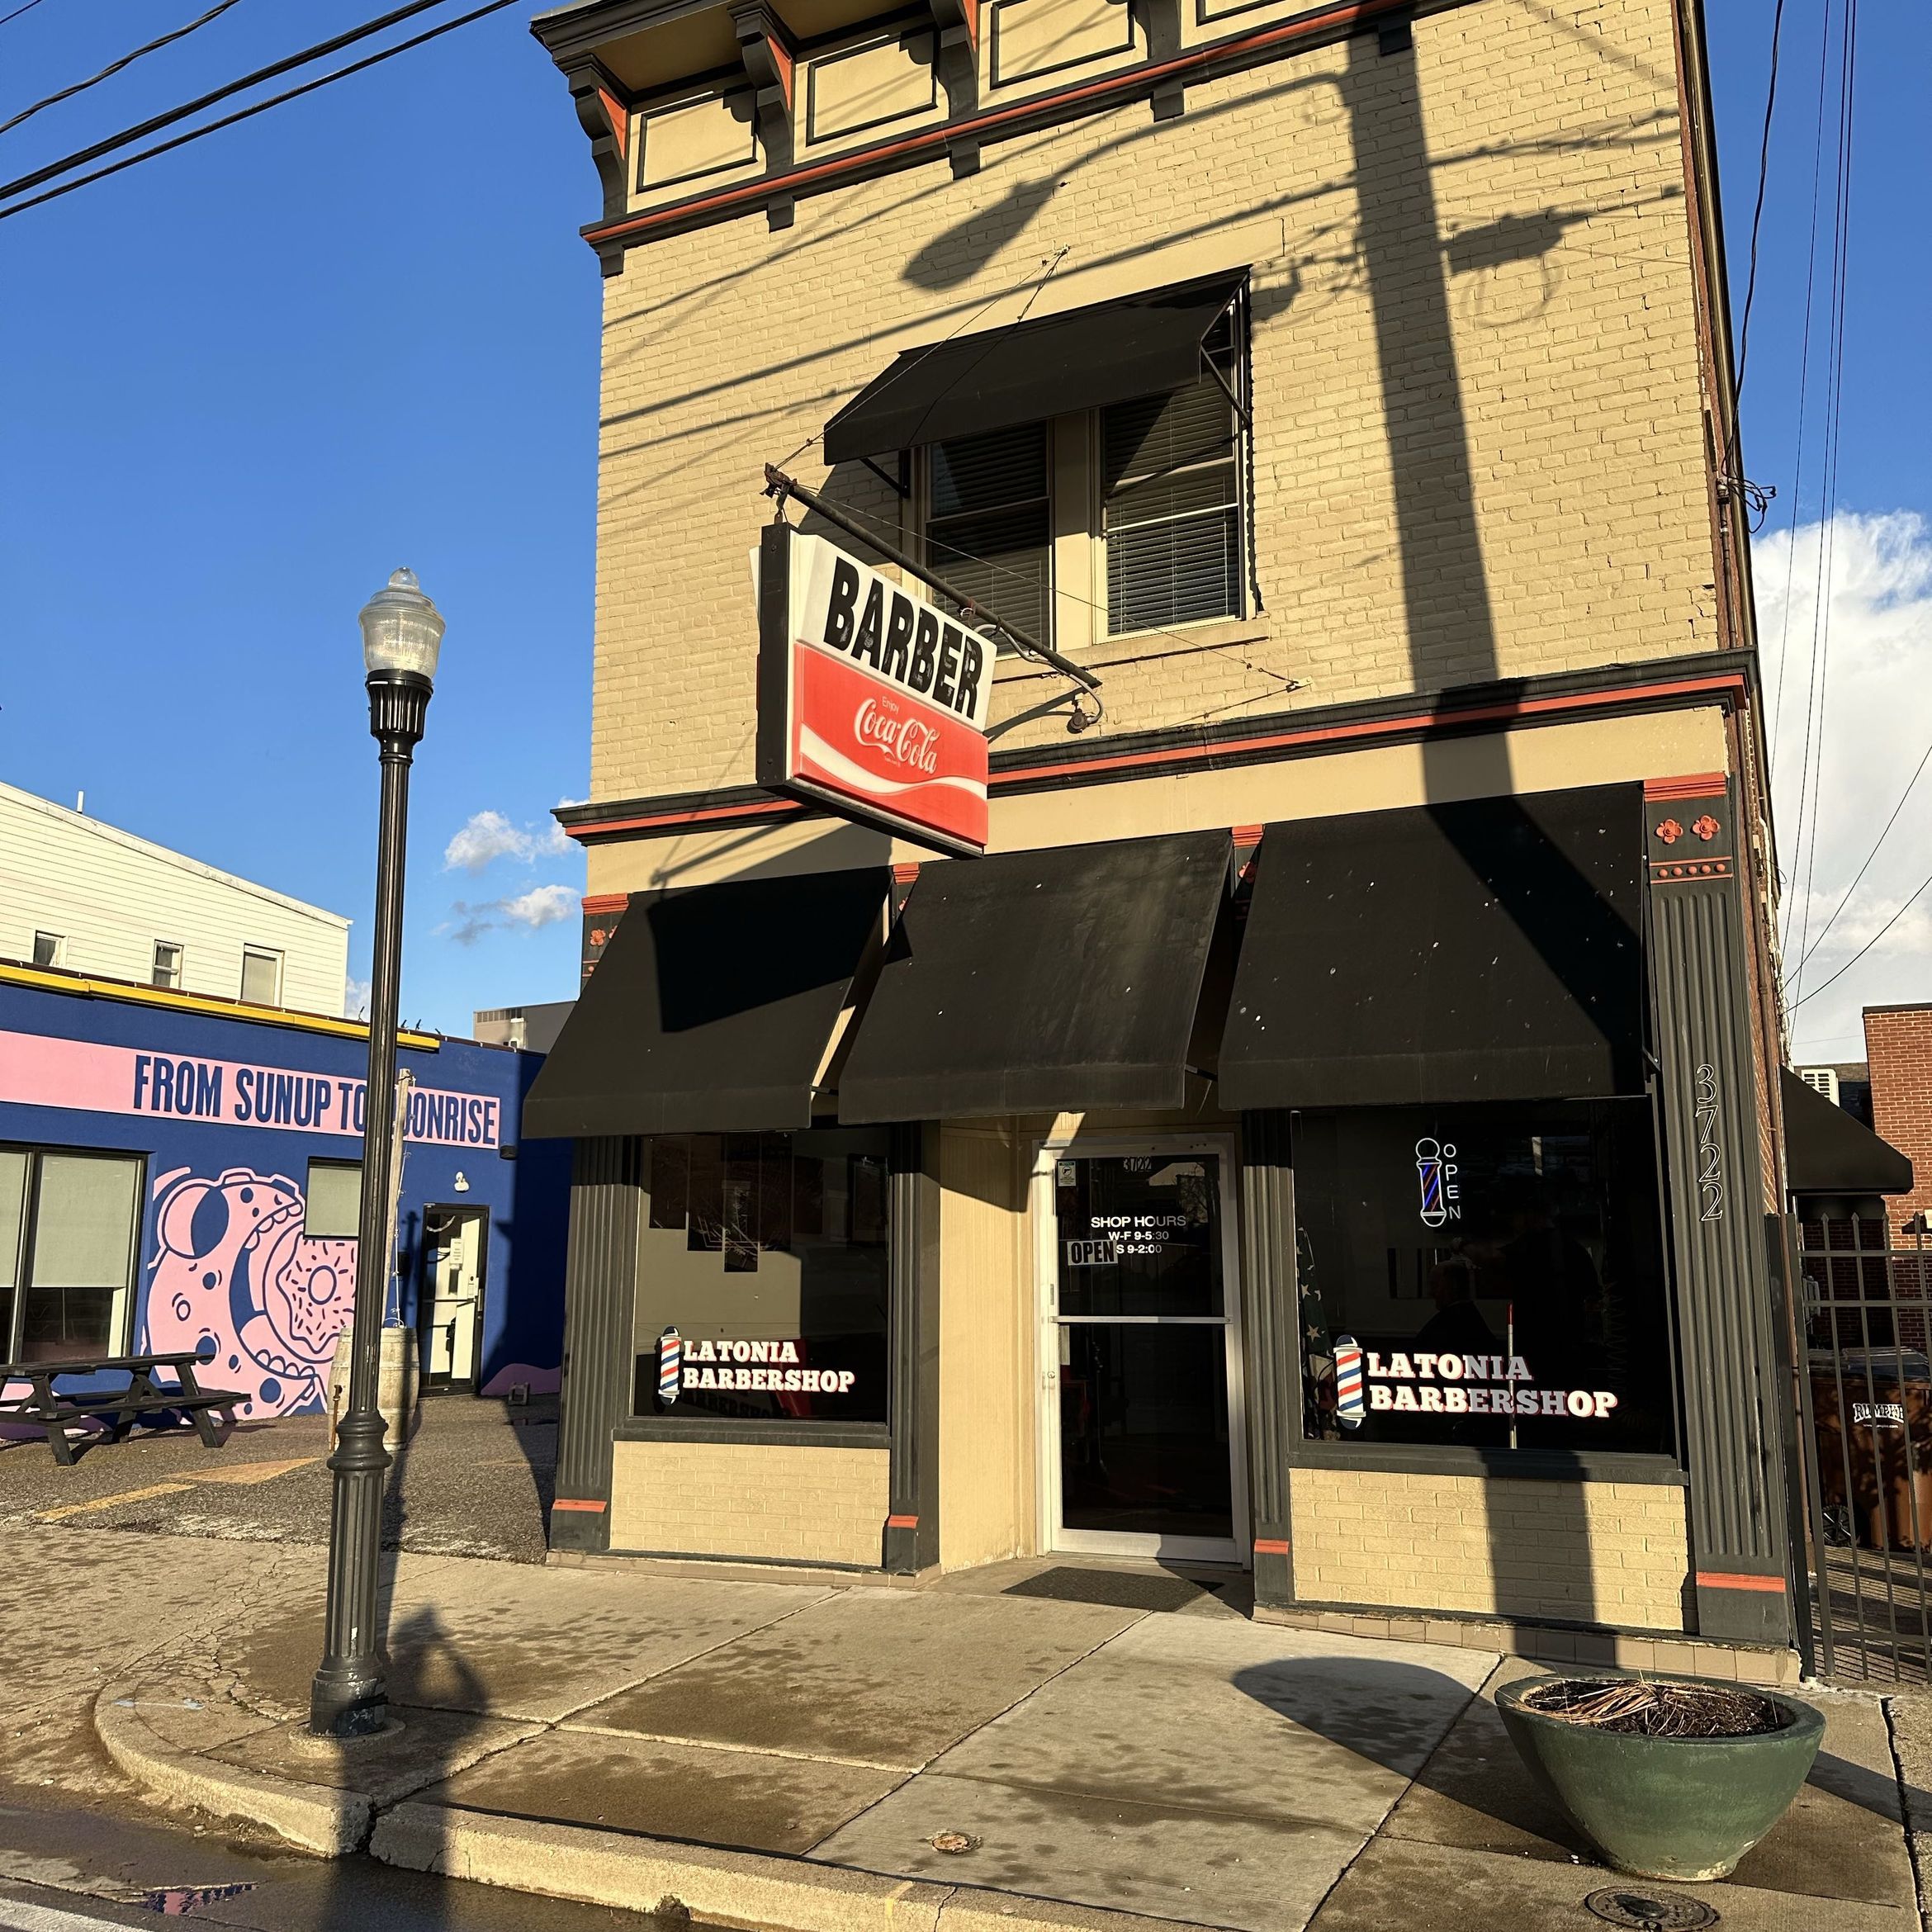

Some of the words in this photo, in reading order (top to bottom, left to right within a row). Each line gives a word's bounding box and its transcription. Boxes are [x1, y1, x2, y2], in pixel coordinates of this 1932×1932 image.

[823, 556, 983, 721] BARBER
[881, 696, 900, 715] Enjoy
[854, 698, 941, 774] Coca-Cola
[133, 1054, 223, 1118] FROM
[234, 1068, 331, 1128] SUNUP
[338, 1082, 367, 1131] TO
[395, 1088, 497, 1145] ONRISE
[1694, 1063, 1723, 1222] 3722
[1123, 1156, 1153, 1171] 3722
[1442, 1143, 1462, 1220] OPEN
[1091, 1216, 1131, 1228] SHOP
[1134, 1215, 1186, 1227] HOURS
[1108, 1231, 1132, 1241] W-F
[1134, 1231, 1169, 1241] 9-5:30
[1115, 1244, 1125, 1254] S
[1127, 1244, 1163, 1254] 9-2:00
[1070, 1242, 1115, 1264] OPEN
[683, 1340, 799, 1363] LATONIA
[1366, 1352, 1534, 1380] LATONIA
[682, 1367, 855, 1393] BARBERSHOP
[1369, 1385, 1618, 1418] BARBERSHOP
